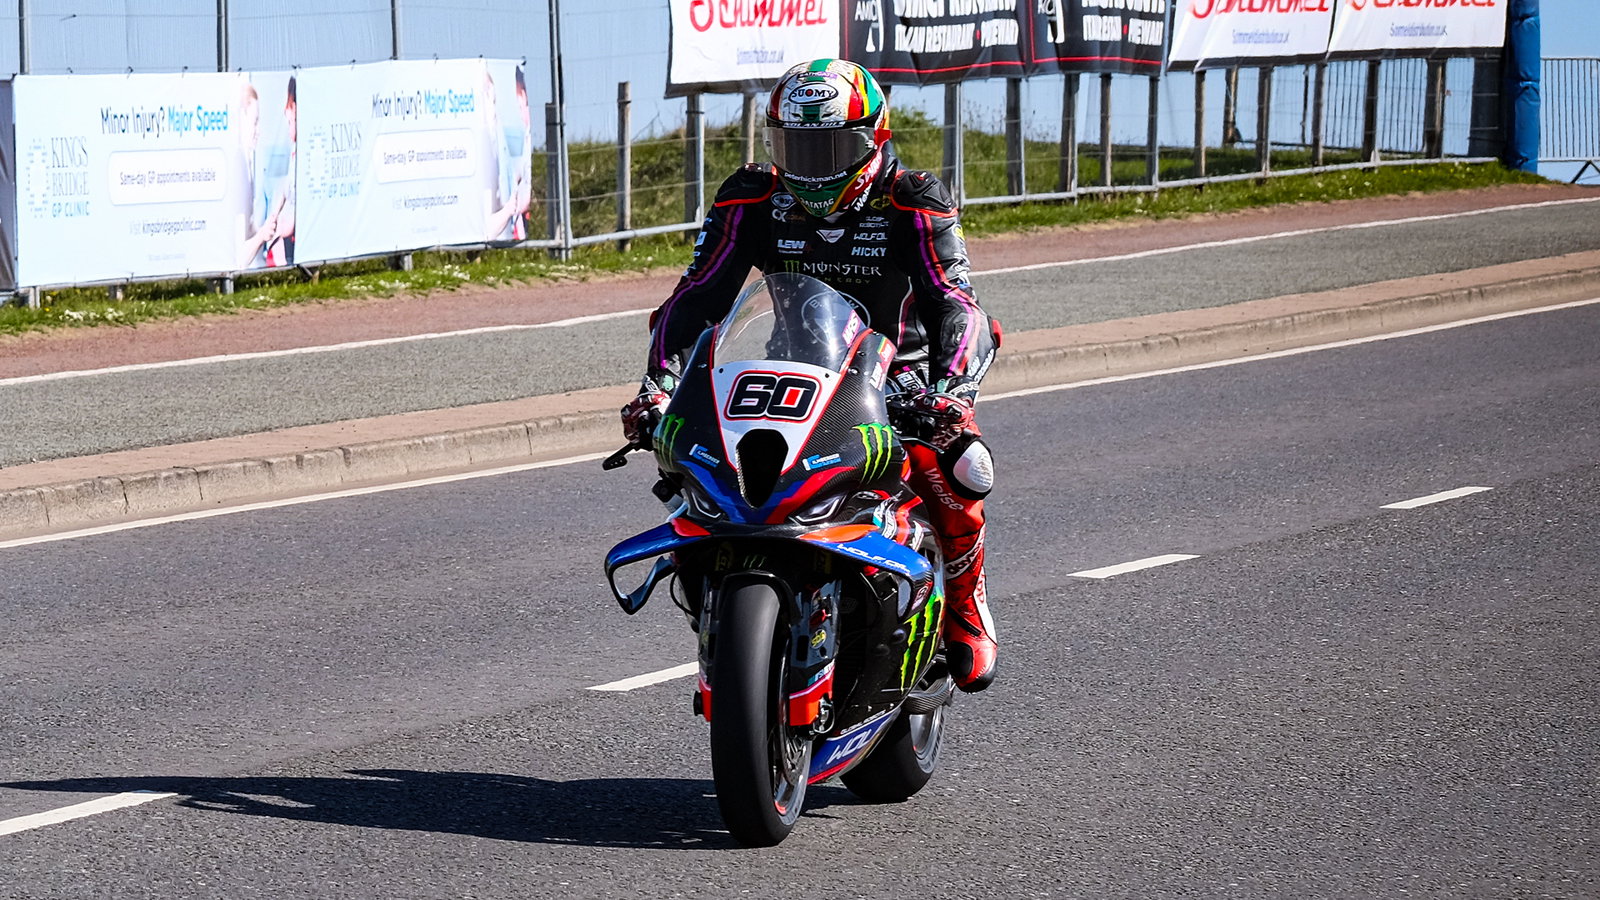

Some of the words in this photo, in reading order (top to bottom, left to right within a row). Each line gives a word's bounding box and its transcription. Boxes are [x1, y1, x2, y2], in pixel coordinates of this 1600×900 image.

[372, 92, 391, 119] Minor
[394, 90, 422, 121] Injury?
[424, 88, 446, 119] Major
[448, 88, 475, 119] Speed
[791, 88, 834, 98] SUOMY
[101, 105, 129, 134] Minor
[132, 105, 165, 139] Injury?
[168, 104, 193, 138] Major
[196, 104, 228, 137] Speed
[331, 121, 361, 152] KINGS
[51, 135, 89, 169] KINGS
[52, 171, 90, 196] BRIDGE
[784, 170, 848, 182] peterhickman.net
[52, 202, 62, 218] GP
[65, 200, 90, 217] CLINIC
[851, 246, 887, 257] HICKY
[803, 261, 882, 276] MONSTER
[727, 374, 818, 418] 60
[924, 467, 964, 511] Weise
